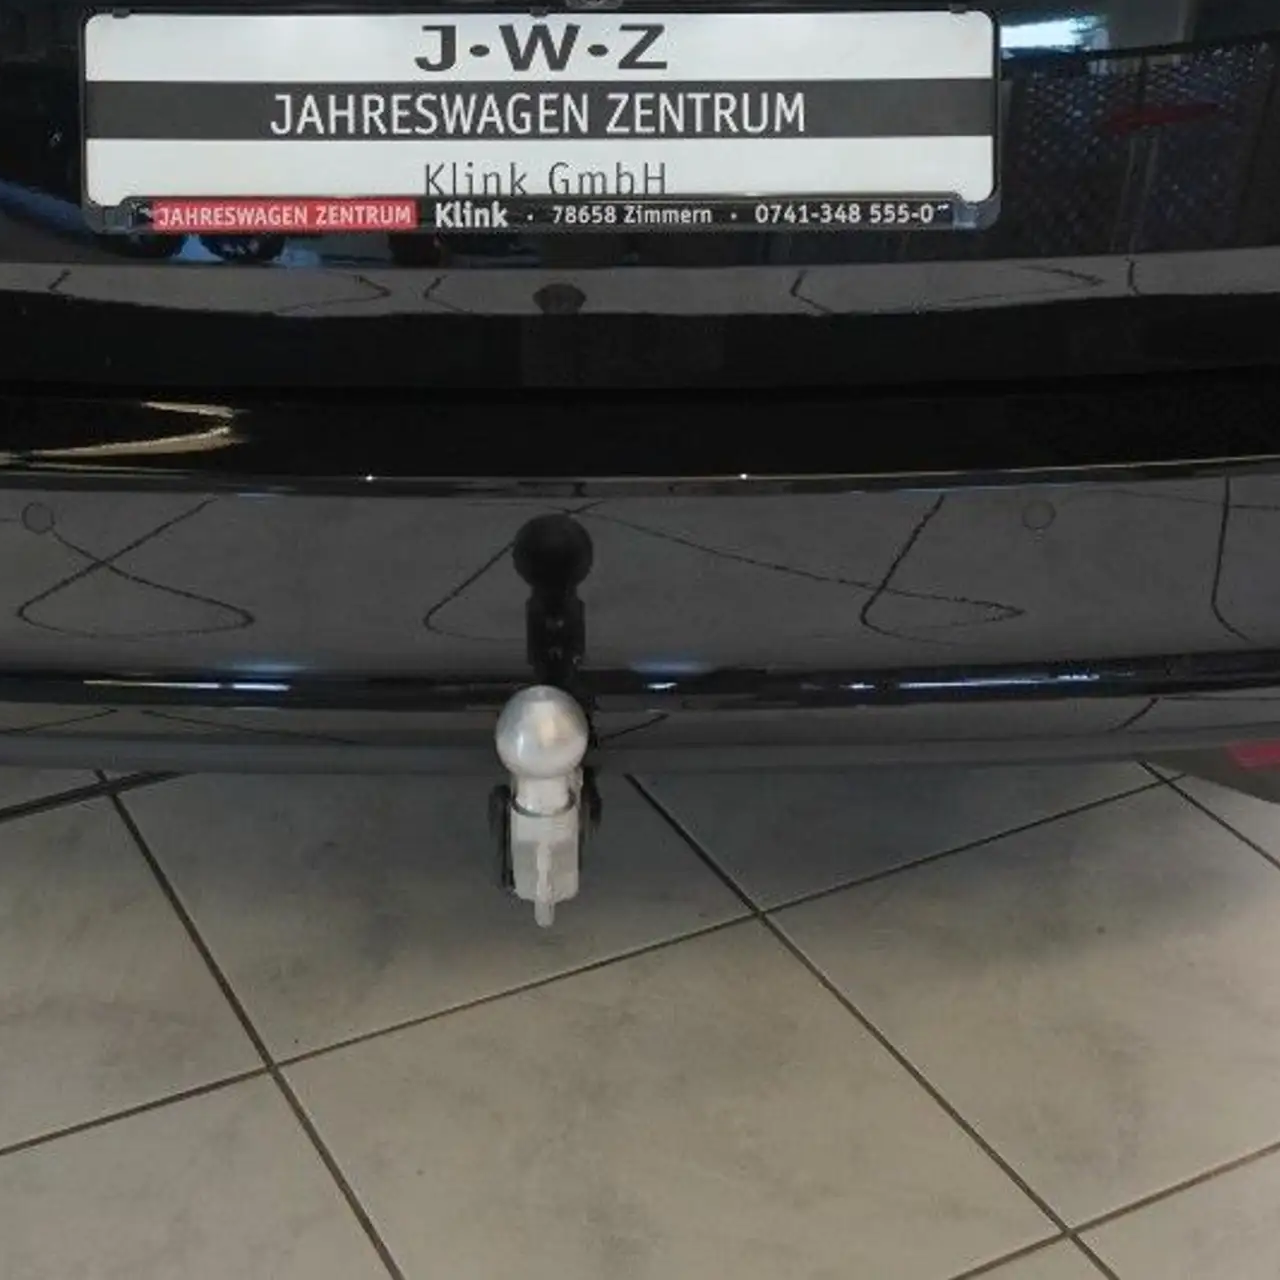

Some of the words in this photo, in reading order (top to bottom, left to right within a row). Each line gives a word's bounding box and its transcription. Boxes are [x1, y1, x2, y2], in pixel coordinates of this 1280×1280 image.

[269, 92, 588, 137] JAHRESWAGEN
[605, 91, 807, 135] ZENTRUM
[425, 161, 528, 196] Klink
[548, 161, 667, 196] GmbH
[157, 205, 309, 227] JAHRESWAGEN
[315, 204, 413, 226] ZENTRUM
[434, 200, 510, 228] Klink
[552, 204, 617, 224] 78658
[622, 203, 713, 225] Zimmern
[754, 203, 862, 224] 0741-348
